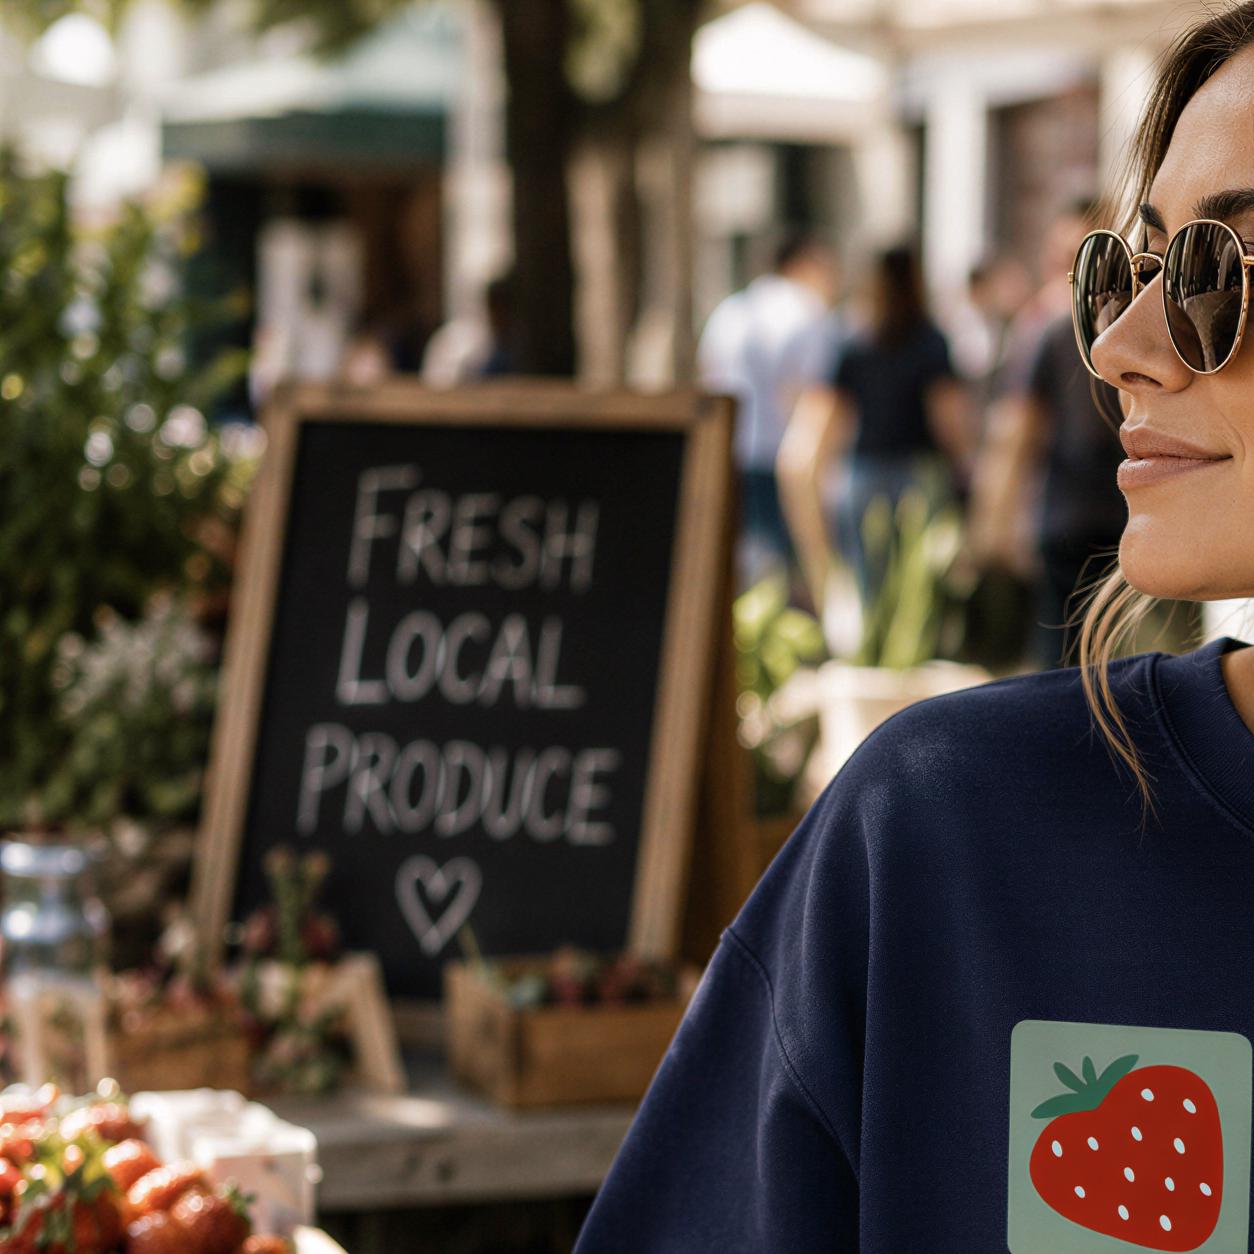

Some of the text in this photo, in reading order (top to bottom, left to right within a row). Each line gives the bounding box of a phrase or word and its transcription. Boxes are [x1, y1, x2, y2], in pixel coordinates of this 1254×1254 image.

[348, 464, 599, 592] FRESH
[336, 597, 586, 708] LOCAL
[297, 722, 622, 845] PRODUCE
